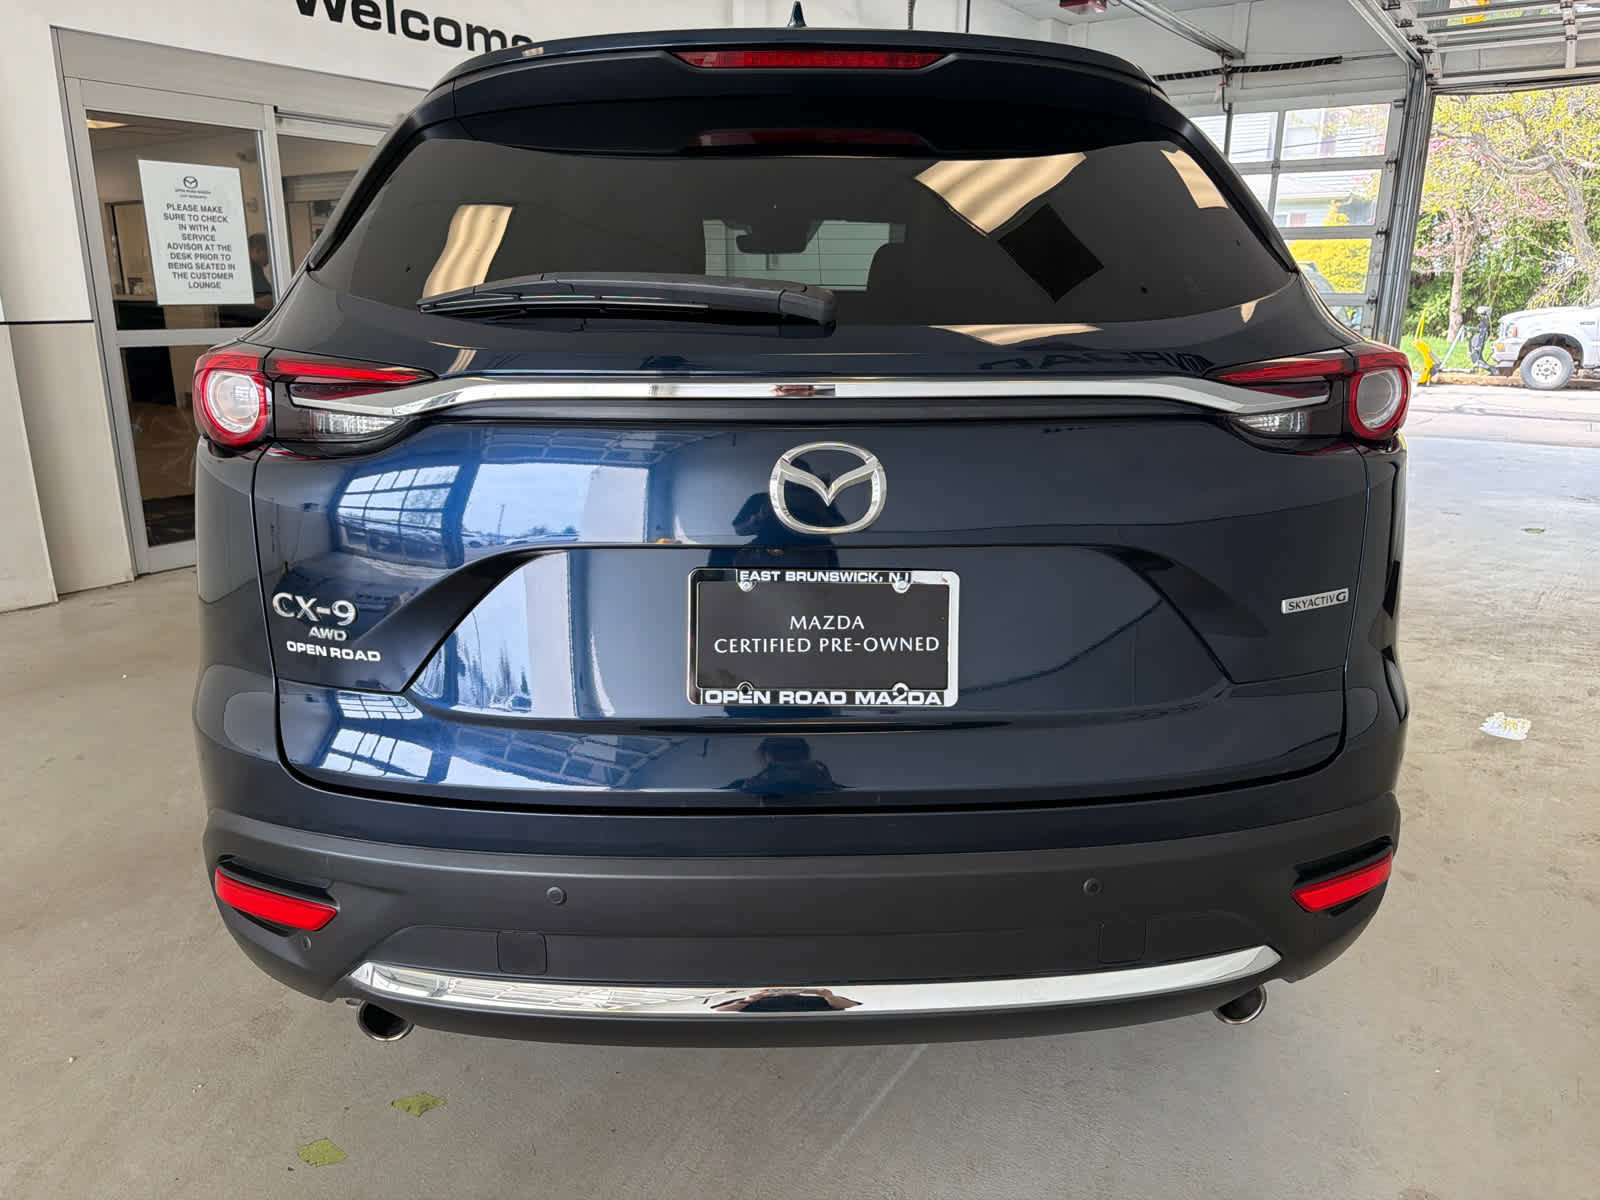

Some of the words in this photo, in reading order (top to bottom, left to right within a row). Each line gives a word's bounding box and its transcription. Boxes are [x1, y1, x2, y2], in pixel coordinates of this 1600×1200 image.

[166, 203, 199, 212] PLEASE
[200, 204, 223, 213] MAKE
[163, 213, 185, 221] SURE
[201, 215, 228, 223] CHECK
[178, 223, 187, 231] IN
[189, 224, 209, 232] WITH
[181, 233, 216, 241] SERVICE
[167, 243, 203, 251] ADVISOR
[217, 244, 231, 252] THE
[194, 253, 218, 261] PRIOR
[168, 262, 193, 270] BEING
[195, 262, 226, 270] SEATED
[172, 272, 189, 280] THE
[190, 272, 234, 280] CUSTOMER
[188, 281, 221, 289] LOUNGE
[739, 571, 780, 583] EAST
[785, 571, 884, 584] BRUNSWICK,
[272, 592, 357, 626] CX-9
[790, 615, 864, 630] MAZDA
[308, 626, 347, 641] AWD
[714, 638, 811, 653] CERTIFIED
[819, 636, 940, 653] PRE-OWNED
[286, 640, 327, 657] OPEN
[329, 647, 381, 662] ROAD
[705, 690, 770, 704] OPEN
[779, 690, 847, 704] ROAD
[855, 691, 942, 705] MAZDA
